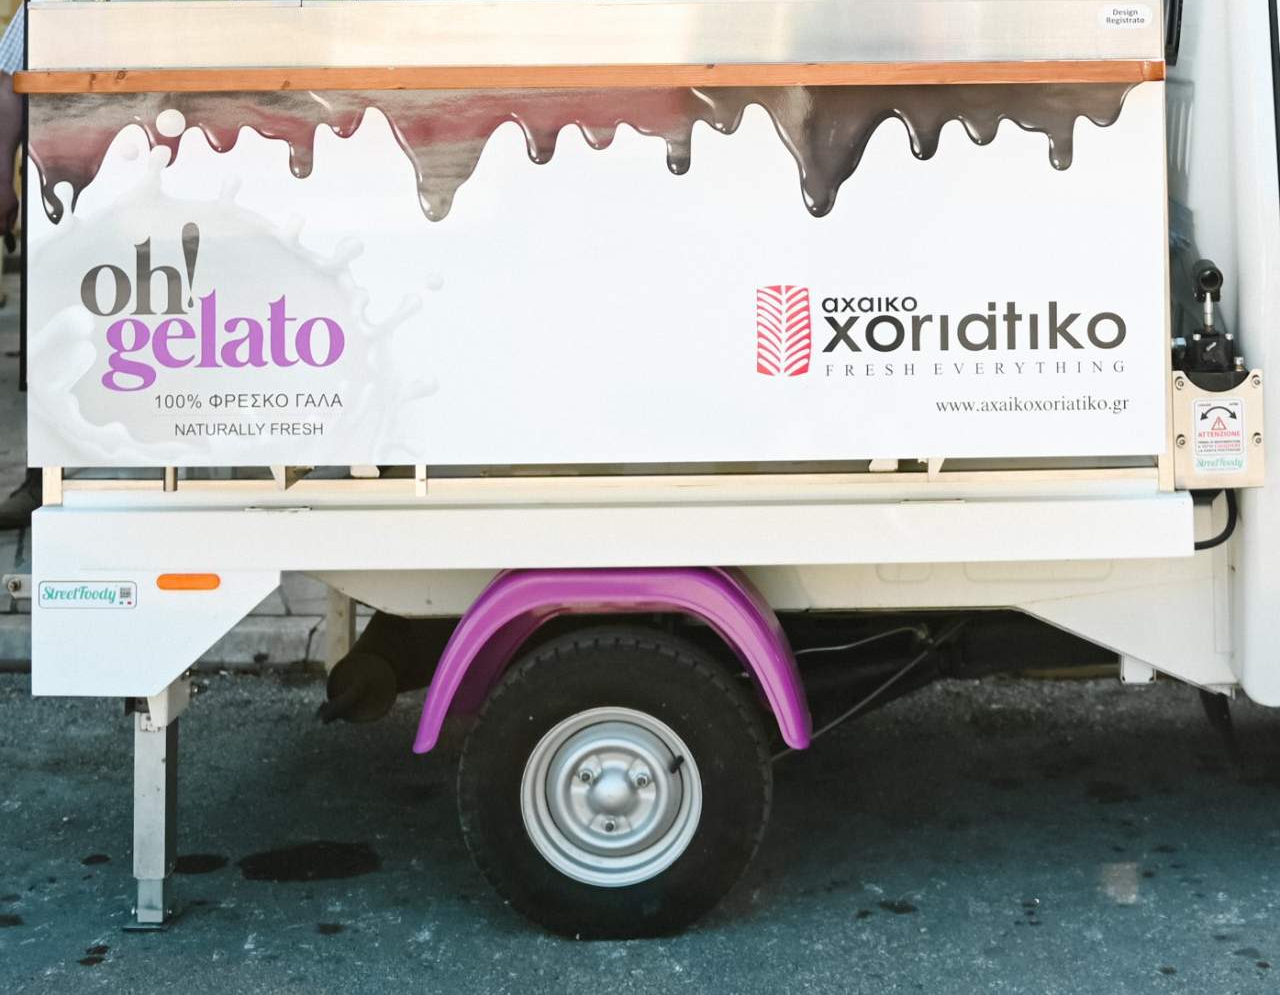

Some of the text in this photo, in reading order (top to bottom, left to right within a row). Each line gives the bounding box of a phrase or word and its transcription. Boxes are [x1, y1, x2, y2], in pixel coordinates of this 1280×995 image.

[1112, 8, 1138, 17] Design
[80, 222, 200, 316] oh!
[101, 288, 346, 392] gelato
[826, 360, 1124, 376] FRESH EVERYTHING
[154, 393, 343, 409] 100% ΦΡΕΣΚΟ ΓΑΛΑ
[936, 395, 1130, 415] www.axaikoxoriatiko.gr
[174, 422, 324, 436] NATURALLY FRESH
